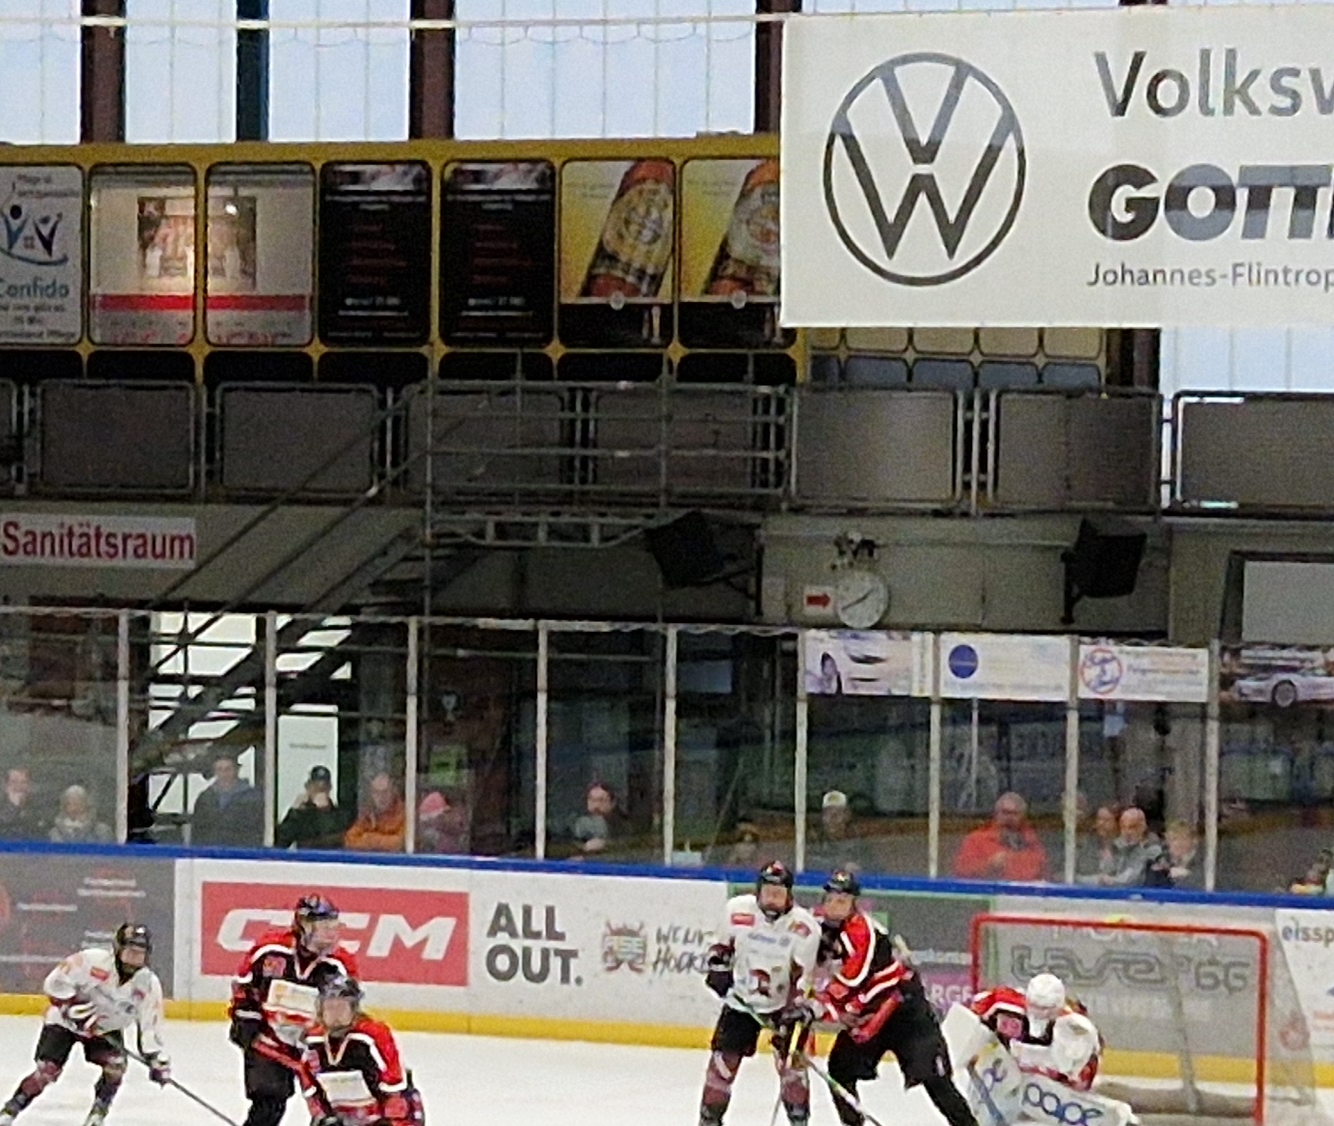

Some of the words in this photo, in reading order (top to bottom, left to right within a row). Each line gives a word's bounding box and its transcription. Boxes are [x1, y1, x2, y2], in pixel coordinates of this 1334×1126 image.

[2, 520, 194, 560] Sanitätsraum
[486, 902, 567, 942] ALL
[485, 944, 582, 986] OUT.
